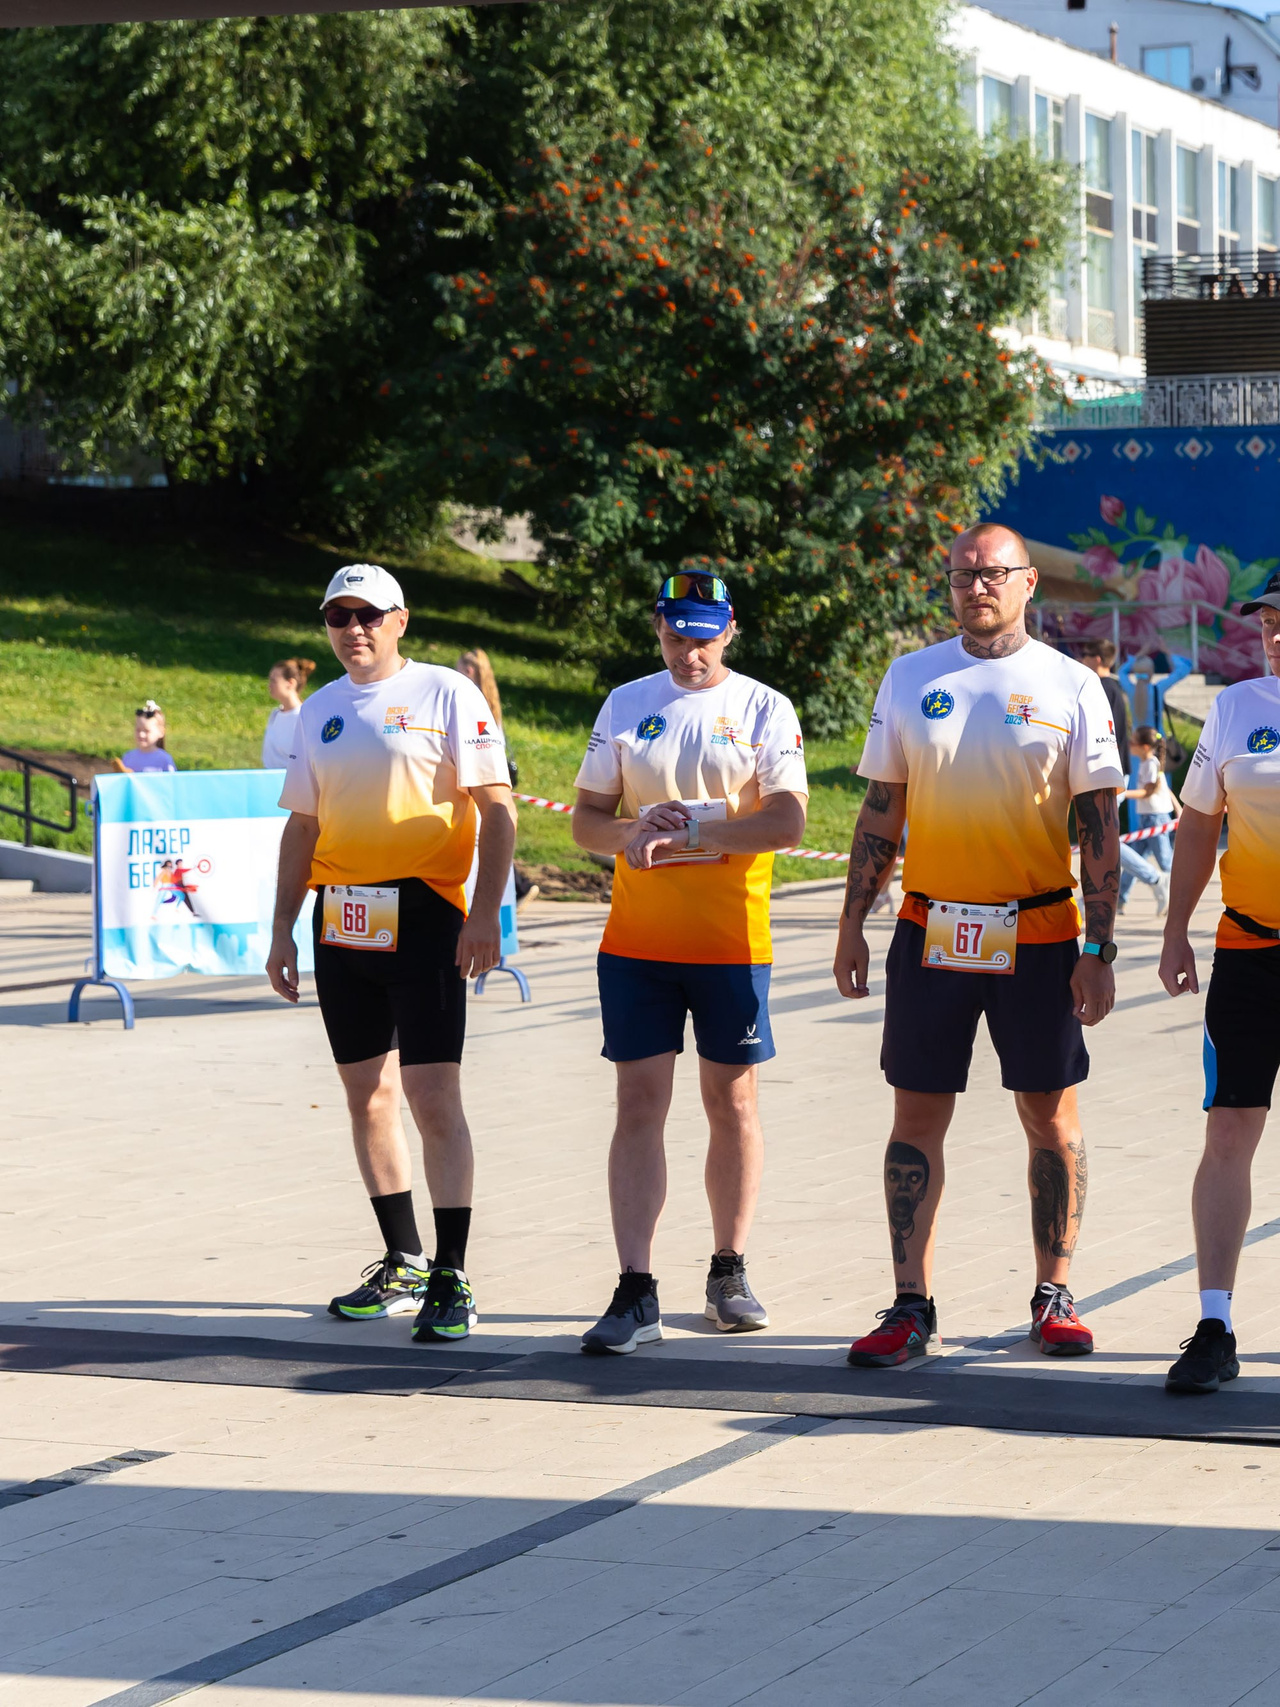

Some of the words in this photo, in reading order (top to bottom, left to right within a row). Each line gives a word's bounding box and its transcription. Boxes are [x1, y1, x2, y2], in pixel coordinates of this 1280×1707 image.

[1008, 693, 1033, 704] ЛАЗЕР
[128, 828, 190, 856] ЛАЗЕР
[128, 861, 162, 889] БЕГ
[343, 902, 366, 932] 68
[956, 922, 983, 955] 67
